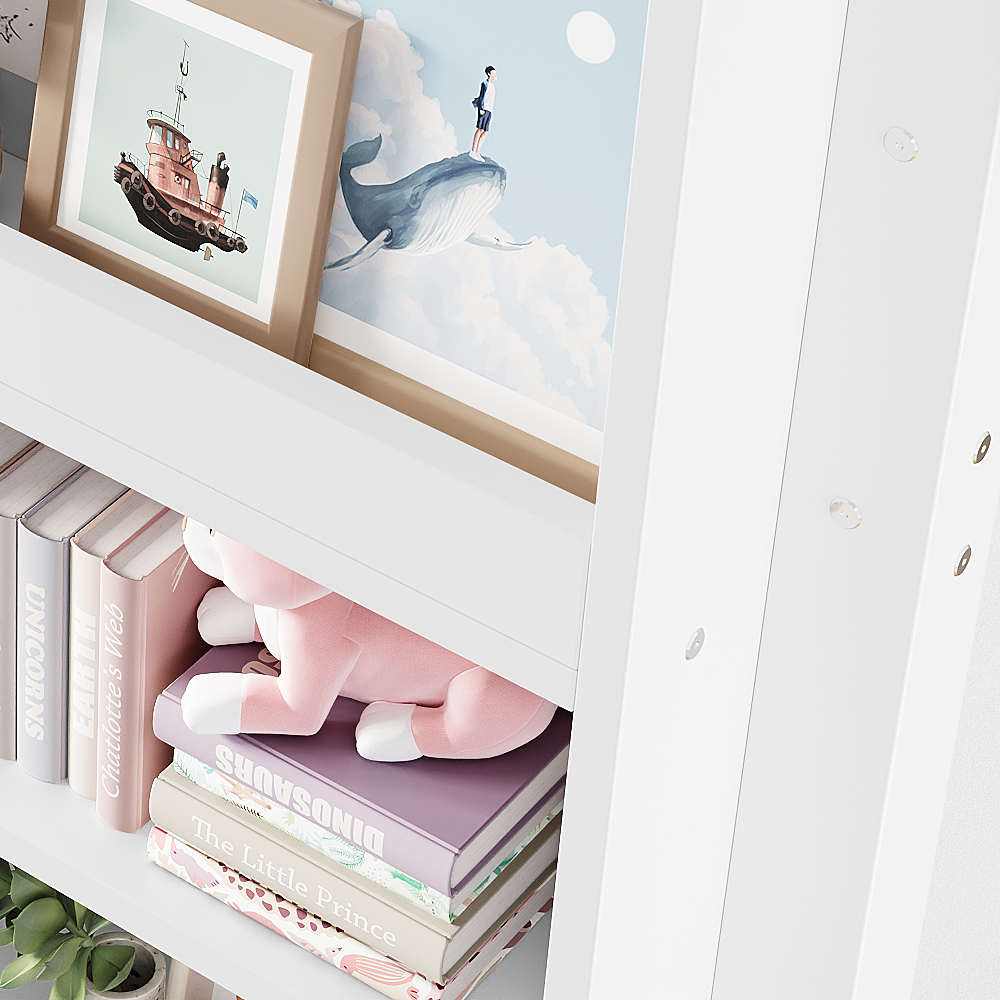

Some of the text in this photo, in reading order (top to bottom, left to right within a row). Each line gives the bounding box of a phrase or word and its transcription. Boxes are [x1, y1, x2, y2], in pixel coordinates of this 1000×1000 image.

[24, 582, 46, 742] UNICORNS
[72, 605, 97, 740] EARTH
[103, 602, 125, 659] Web
[215, 743, 386, 857] DINOSAURS
[190, 814, 397, 948] The Little Prince
